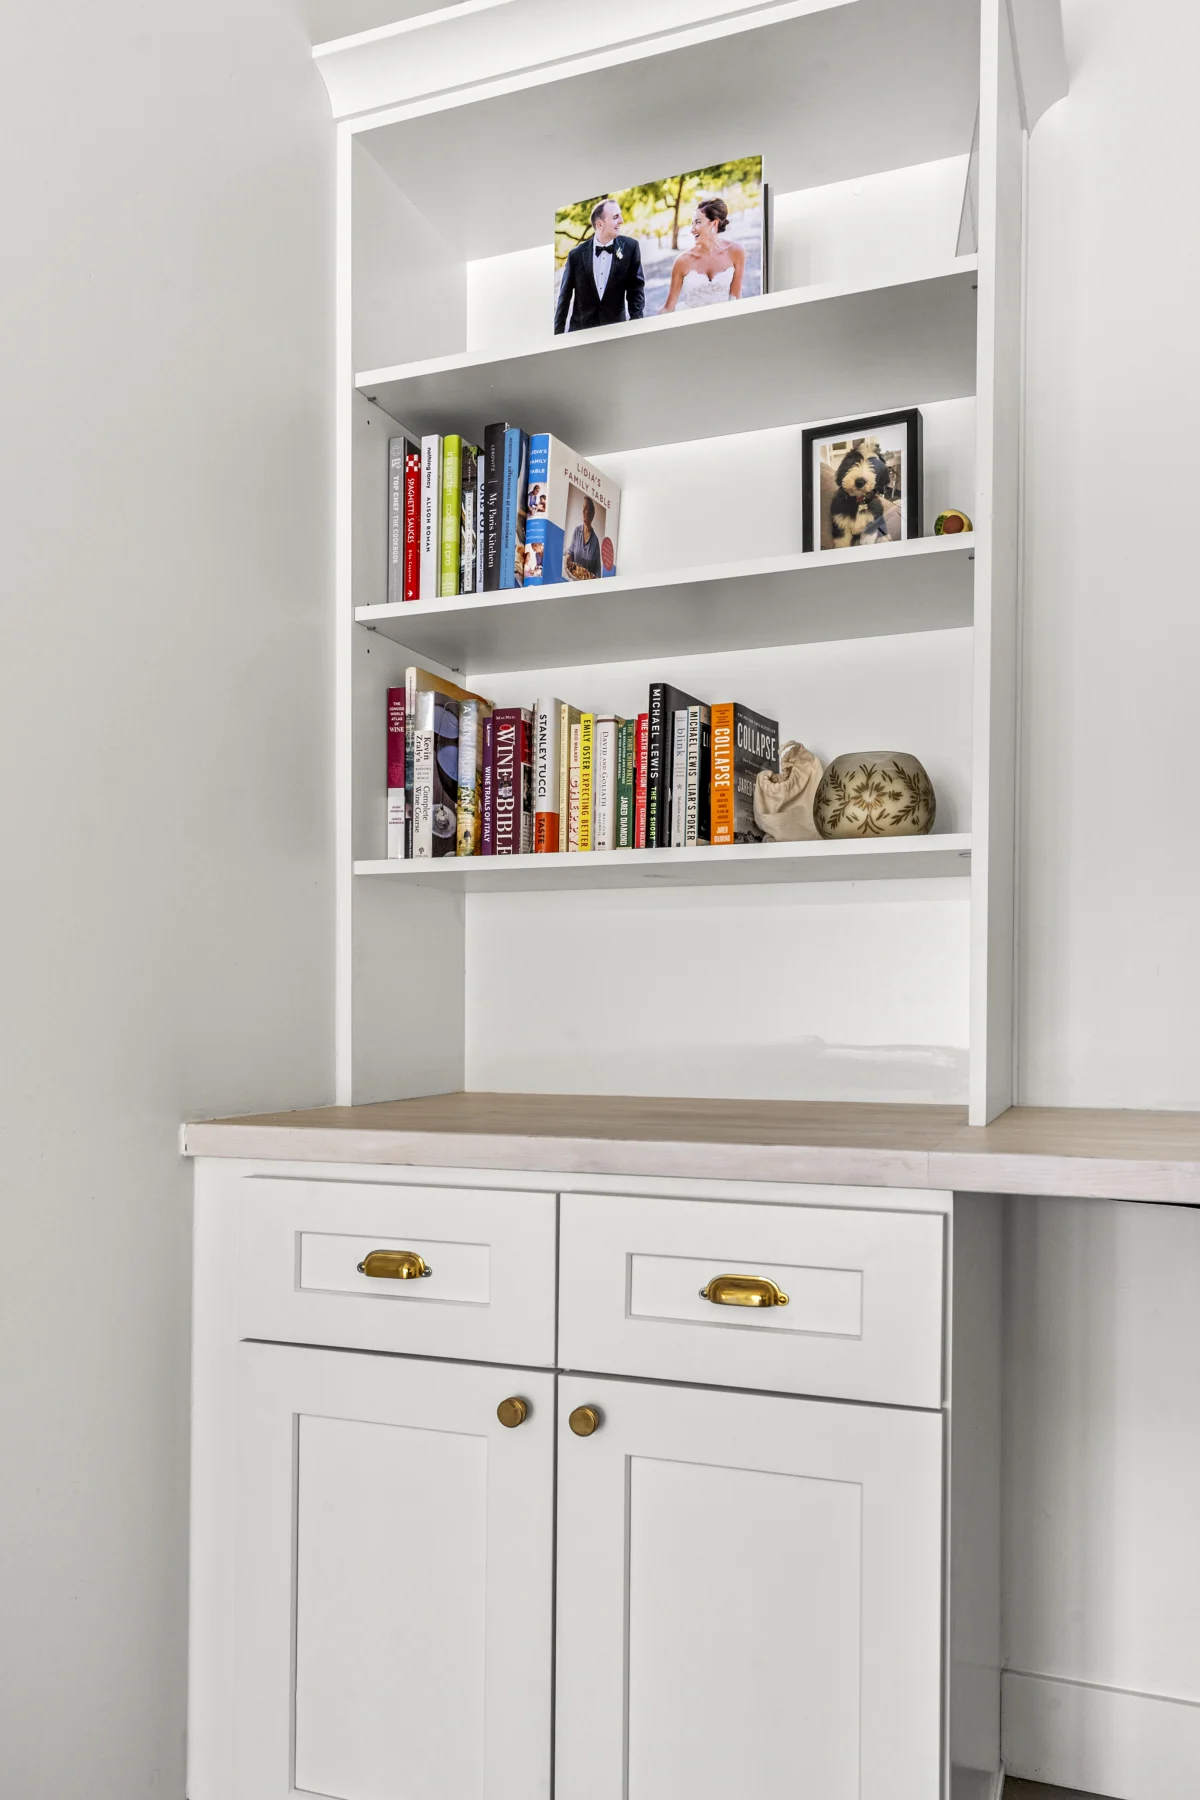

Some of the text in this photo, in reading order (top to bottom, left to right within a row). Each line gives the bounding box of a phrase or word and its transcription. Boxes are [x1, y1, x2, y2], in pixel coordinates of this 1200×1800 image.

[392, 475, 400, 490] TOP
[445, 469, 453, 496] garten
[564, 468, 611, 509] FAMILY TABLE
[577, 463, 601, 487] LIDIA'S
[407, 477, 415, 543] SPAGHETTI SAUCES
[445, 503, 453, 522] cook
[391, 529, 399, 564] COOKBOOK
[445, 523, 453, 542] like
[488, 493, 498, 568] My Paris Kitchen
[444, 551, 452, 566] pro
[463, 706, 471, 714] A
[463, 716, 471, 738] MAN
[641, 719, 649, 731] THE
[415, 735, 423, 763] Zraly's
[650, 689, 661, 779] MICHAEL LEWIS
[676, 728, 685, 757] blink
[737, 722, 776, 761] COLLAPSE
[496, 724, 515, 780] WINE
[538, 714, 547, 798] STANLEY TUCCI
[625, 752, 633, 786] CHIMPANZEE
[714, 728, 730, 787] COLLAPSE
[461, 751, 471, 807] MOUNTAIN
[580, 719, 591, 848] EMILY OSTER EXPECTING BETTER
[640, 751, 648, 788] EXTINCTION
[687, 711, 698, 841] MICHAEL LEWIS LIAR'S POKER
[737, 777, 752, 796] JARED
[414, 785, 422, 806] Wine
[421, 785, 431, 821] Complete
[484, 811, 491, 822] OF
[496, 796, 515, 855] BIBLE
[537, 818, 545, 844] TASTE
[619, 796, 628, 846] JARED DIAMOND
[716, 826, 729, 834] JARED
